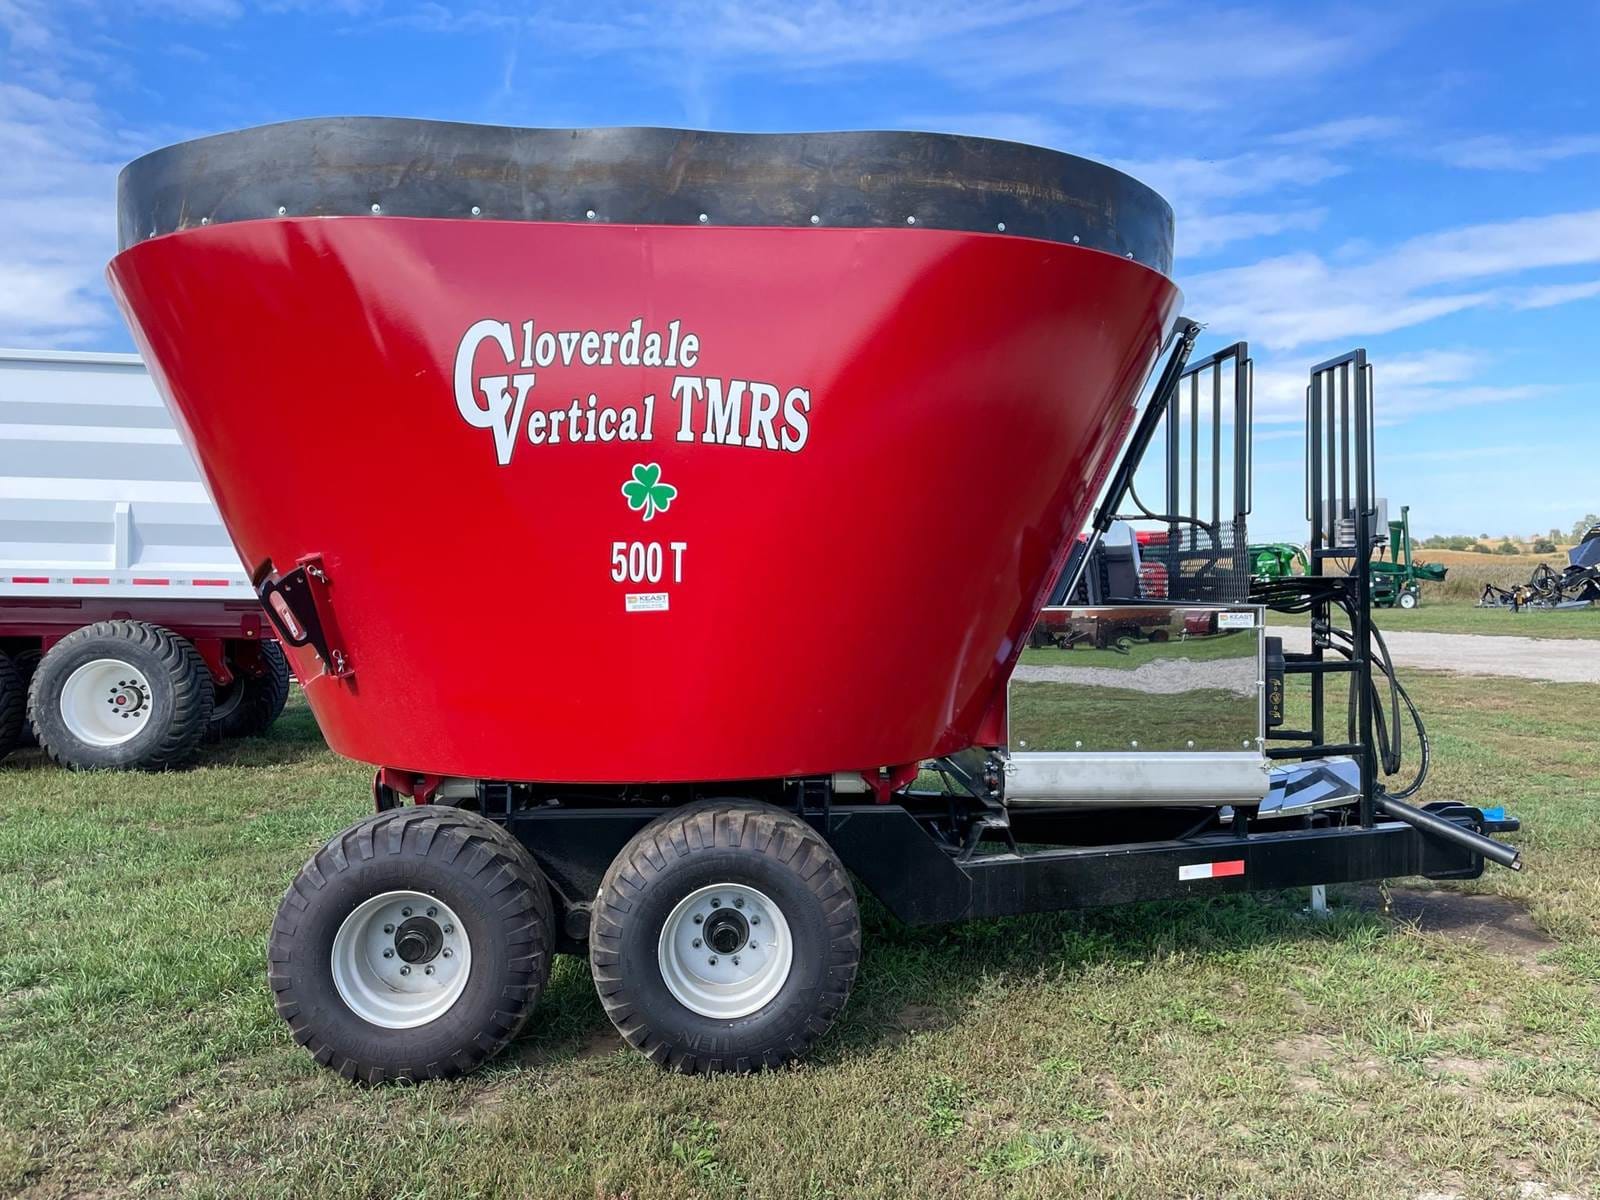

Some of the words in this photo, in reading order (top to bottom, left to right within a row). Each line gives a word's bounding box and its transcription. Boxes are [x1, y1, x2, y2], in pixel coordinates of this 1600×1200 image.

[453, 318, 700, 429] Cloverdale
[479, 373, 655, 465] Vertical
[671, 375, 812, 453] TMRS
[611, 541, 663, 583] 500
[670, 541, 687, 583] T
